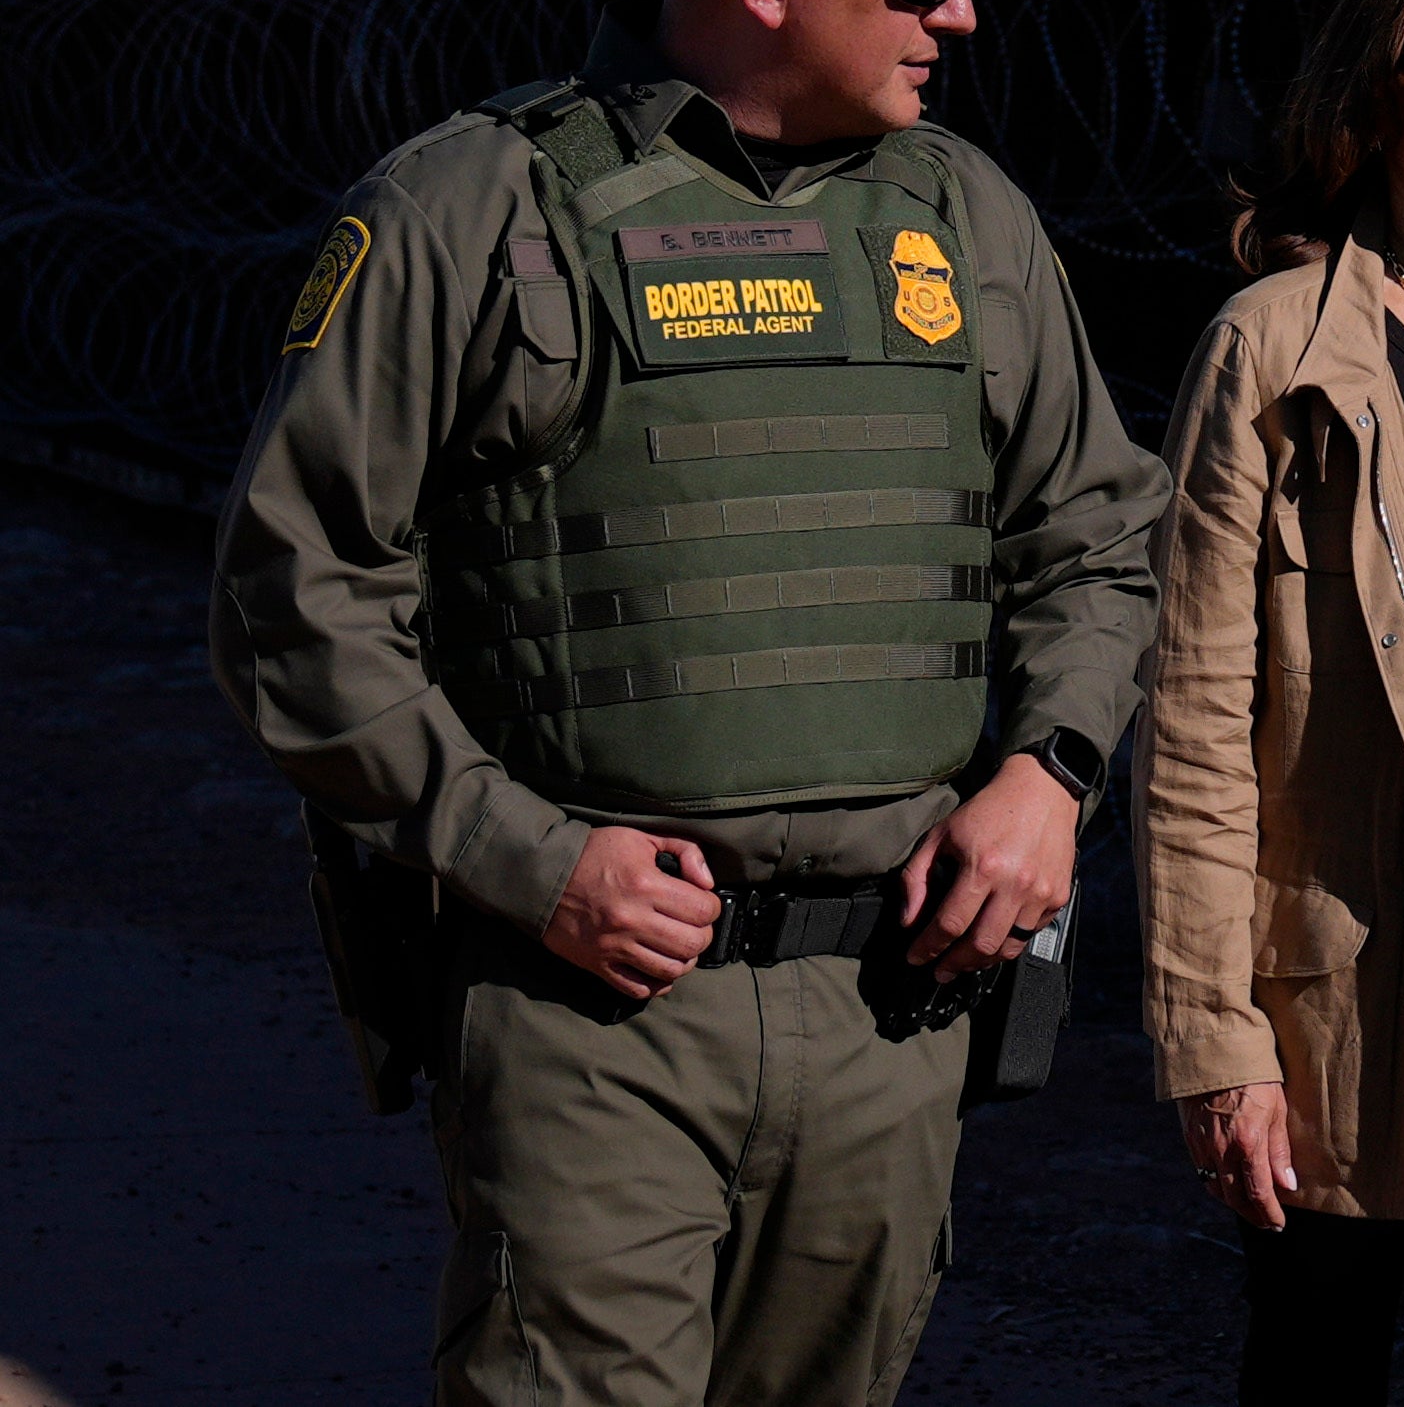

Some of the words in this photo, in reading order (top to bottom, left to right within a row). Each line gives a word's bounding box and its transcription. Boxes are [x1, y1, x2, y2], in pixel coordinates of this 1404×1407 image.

[691, 228, 793, 250] BENNETT
[644, 279, 740, 321] BORDER
[739, 278, 823, 314] PATROL
[903, 290, 911, 301] U
[943, 296, 951, 307] S
[662, 317, 751, 340] FEDERAL
[753, 315, 814, 335] AGENT
